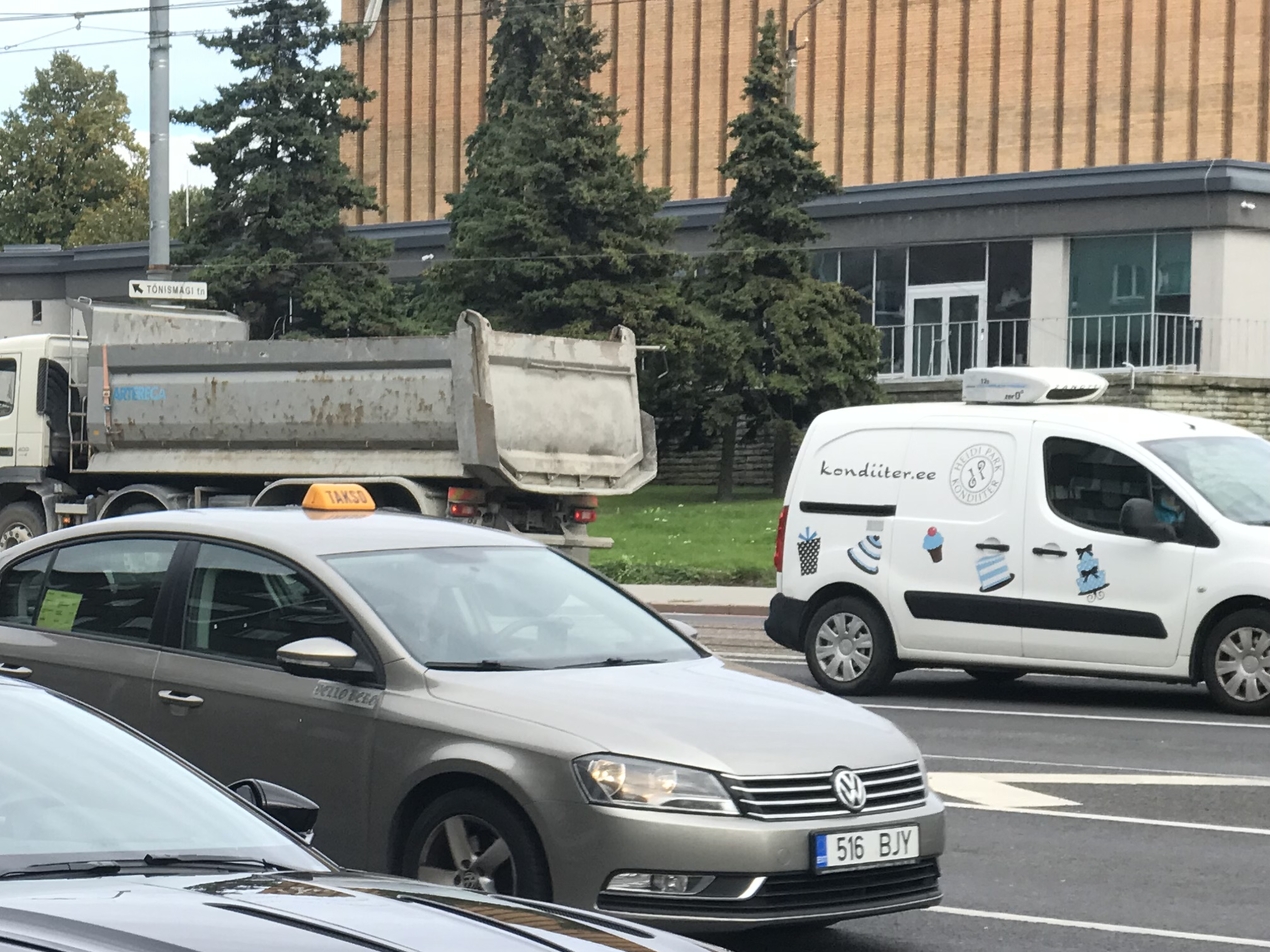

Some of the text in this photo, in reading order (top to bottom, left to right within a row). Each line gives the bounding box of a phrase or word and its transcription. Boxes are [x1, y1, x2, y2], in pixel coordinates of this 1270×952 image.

[820, 460, 936, 481] kondiiter.ee
[954, 446, 1002, 473] HEIDI PARK
[952, 478, 999, 503] KONDIITER
[837, 829, 912, 861] 516 BJY
